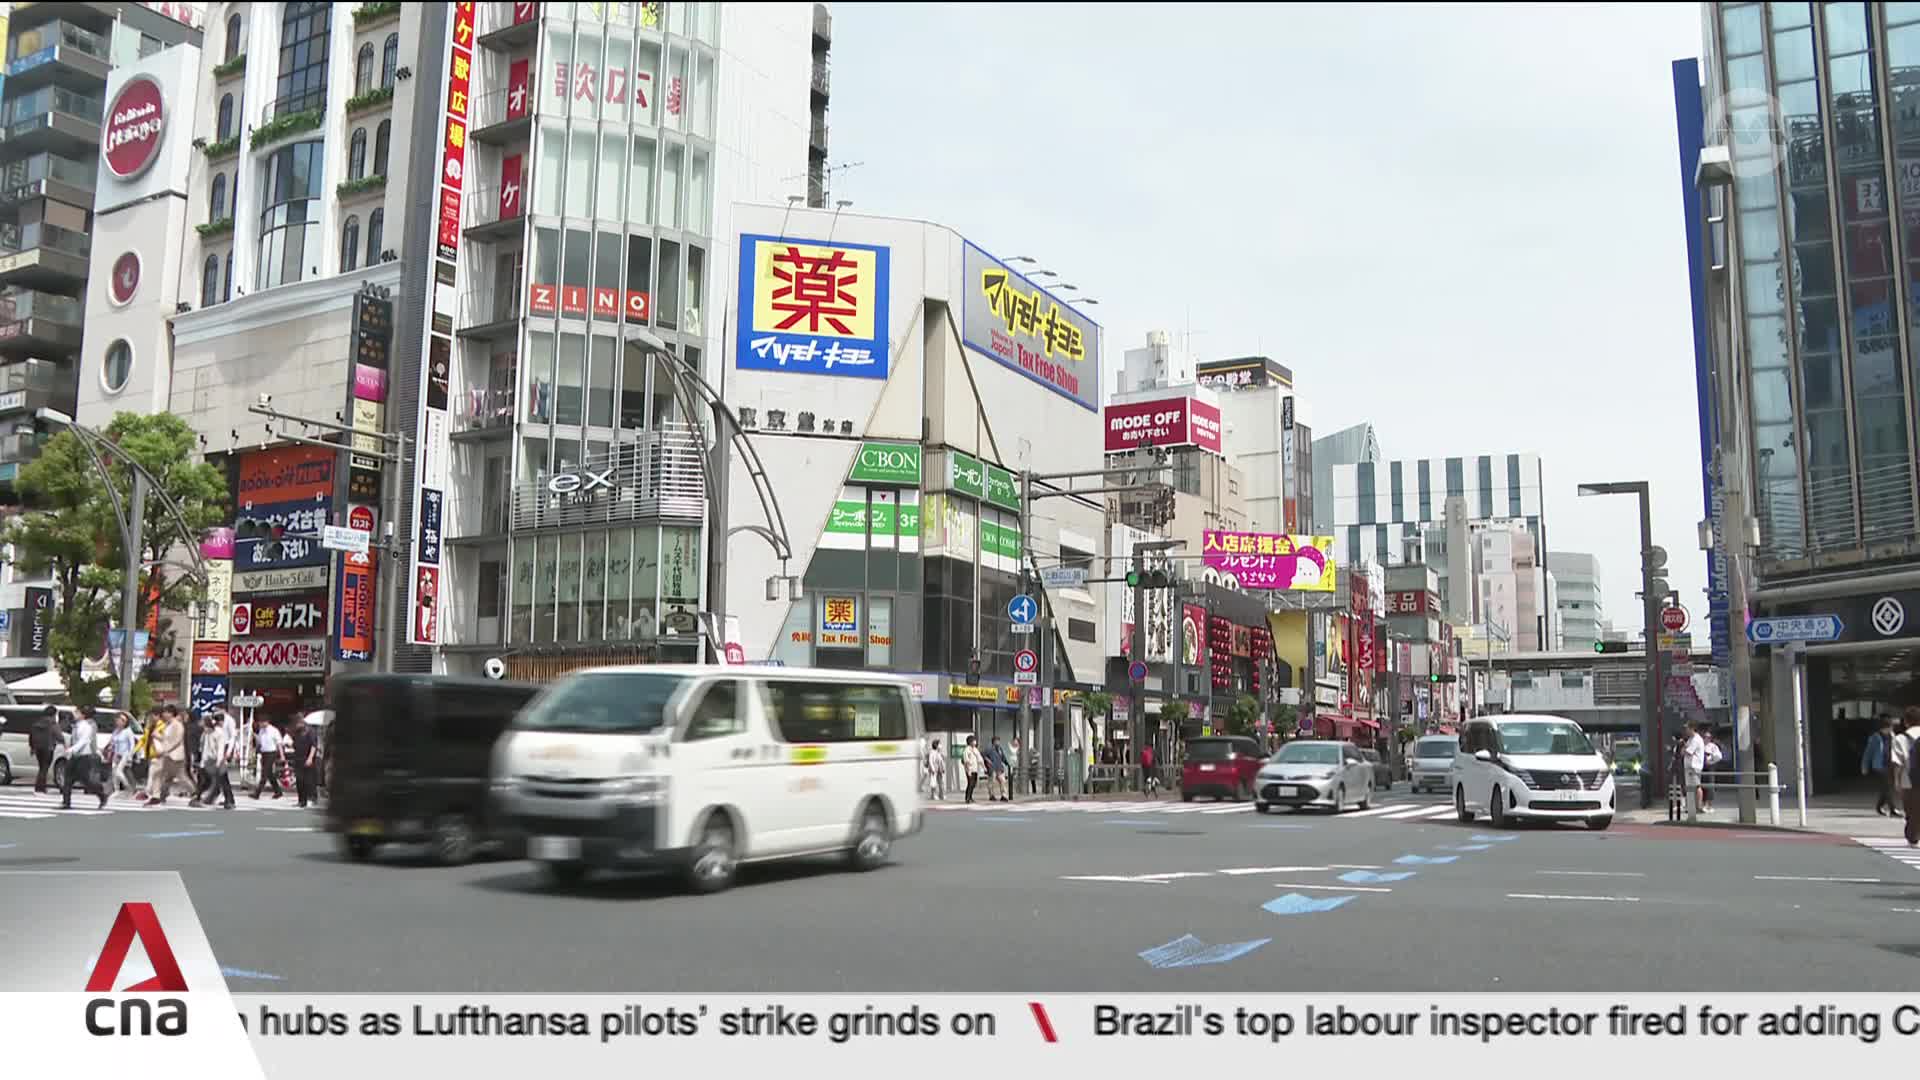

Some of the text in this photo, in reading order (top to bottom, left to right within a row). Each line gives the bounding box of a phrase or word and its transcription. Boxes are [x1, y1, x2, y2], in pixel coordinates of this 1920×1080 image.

[510, 84, 525, 111] オ
[502, 181, 519, 208] ケ
[771, 247, 858, 335] 薬
[982, 270, 1084, 357] マツモトキヨシ
[751, 336, 875, 369] マツモトキヨシ
[1017, 343, 1078, 395] Tax Free Shop
[1111, 411, 1180, 430] MODE OFF
[1123, 428, 1169, 441] お売り下さい
[352, 519, 371, 529] ガスト
[900, 514, 918, 528] 3F
[255, 608, 275, 619] Café
[277, 604, 321, 628] ガスト
[828, 600, 851, 622] 薬
[1777, 620, 1828, 631] 中央通り
[822, 634, 891, 645] Tax Free Shop
[200, 656, 220, 672] 本
[192, 684, 226, 695] ゲーム
